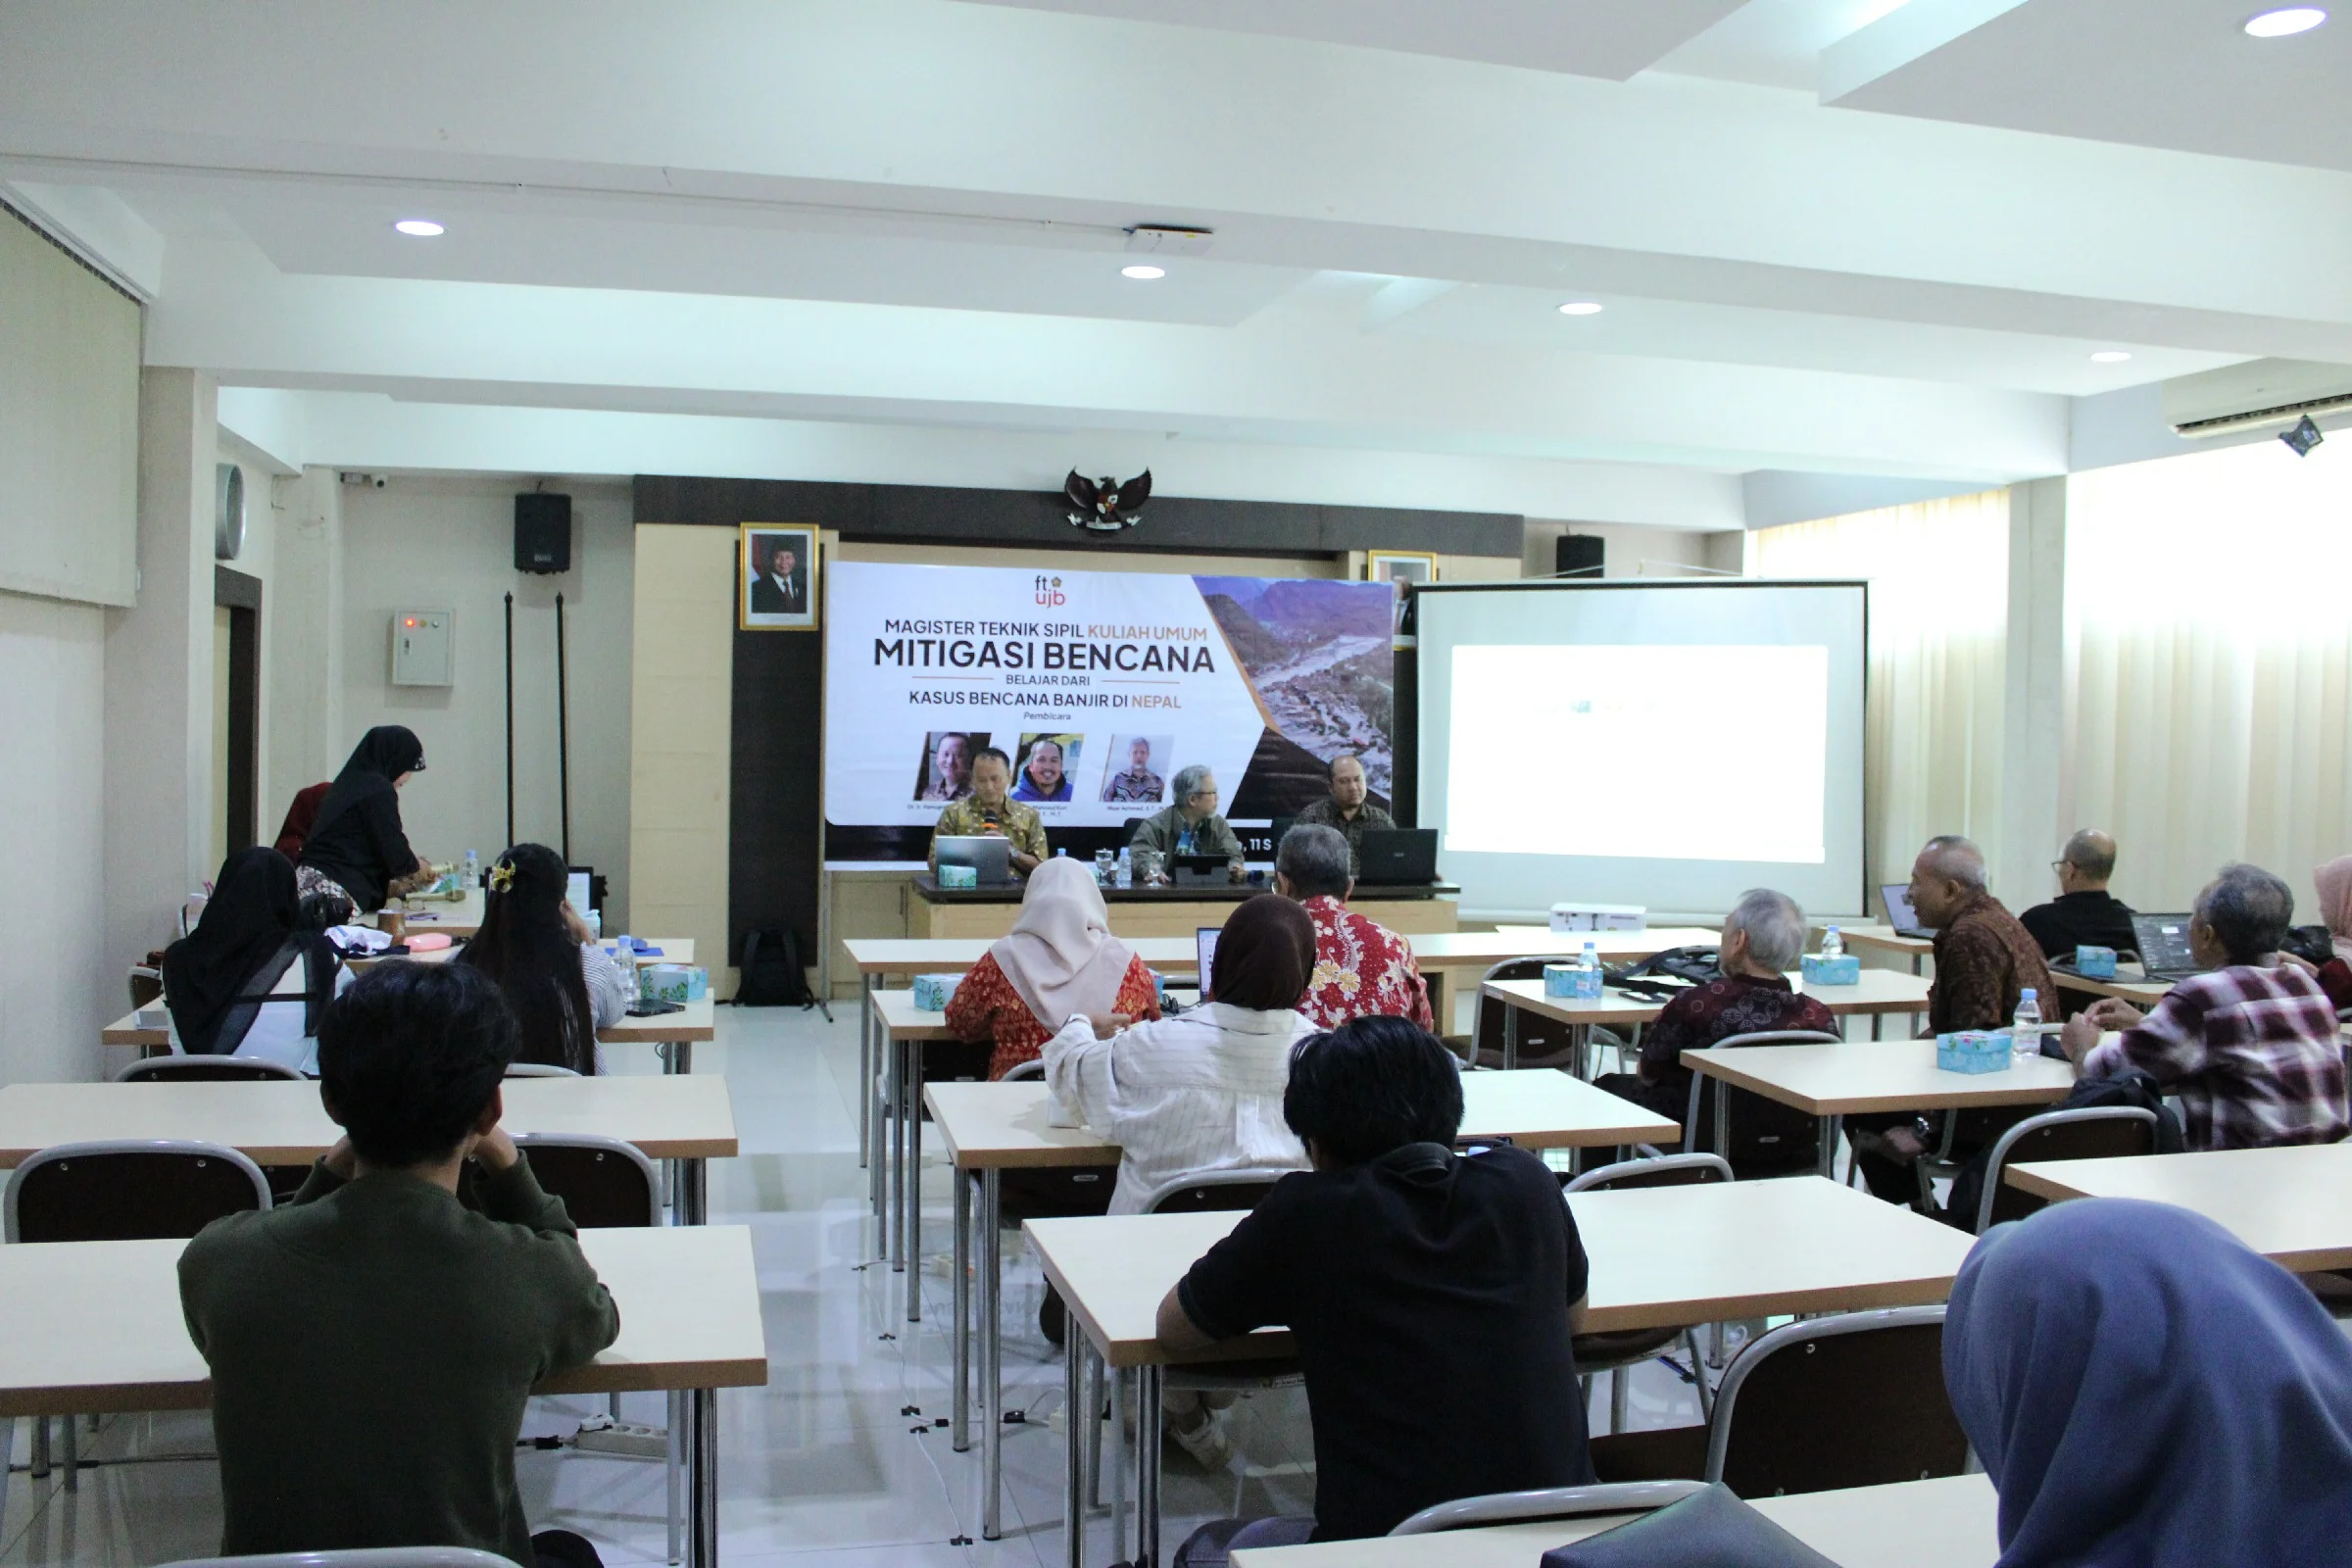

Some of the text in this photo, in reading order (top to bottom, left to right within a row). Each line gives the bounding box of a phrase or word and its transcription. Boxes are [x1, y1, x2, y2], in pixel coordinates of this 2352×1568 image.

[1035, 589, 1066, 609] ujb
[885, 618, 1207, 641] MAGISTER TEKNIK SIPIL KULIAH UMUM
[874, 638, 1215, 673] MITIGASI BENCANA
[1006, 674, 1090, 686] BELAJAR DARI
[909, 691, 1182, 709] KASUS BENCANA BANJIR DI NEPAL
[1023, 711, 1072, 720] Pembicara
[1249, 837, 1261, 851] 11
